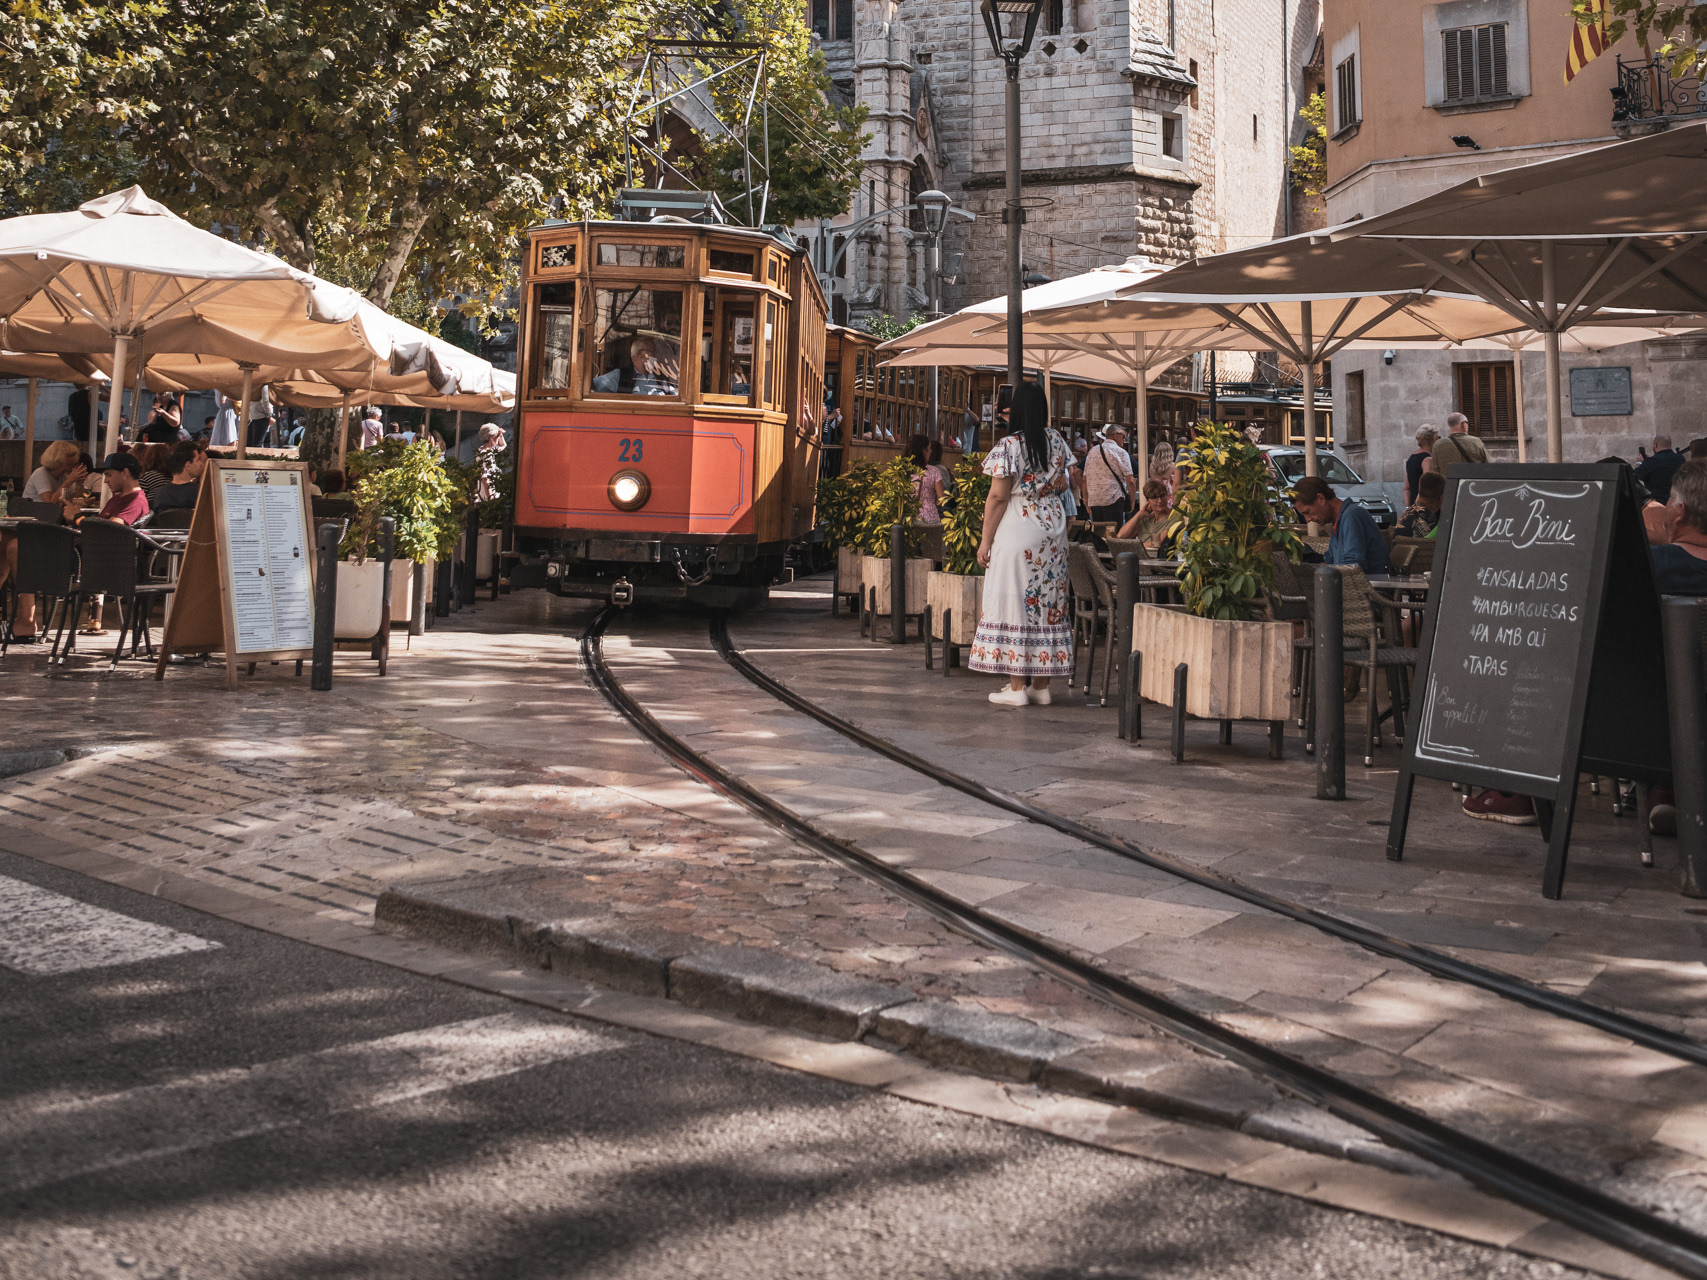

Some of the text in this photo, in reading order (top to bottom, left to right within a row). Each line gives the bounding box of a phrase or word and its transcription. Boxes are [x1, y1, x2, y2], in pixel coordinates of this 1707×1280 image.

[618, 438, 643, 463] 23
[1470, 498, 1575, 548] Bar Bini
[1482, 567, 1568, 591] ENSALADAS
[1474, 598, 1578, 621] HAMBURGUESAS
[1474, 623, 1489, 642] PA
[1495, 626, 1522, 646] AMB
[1469, 655, 1508, 676] TAPAS
[1436, 685, 1456, 705] Bon
